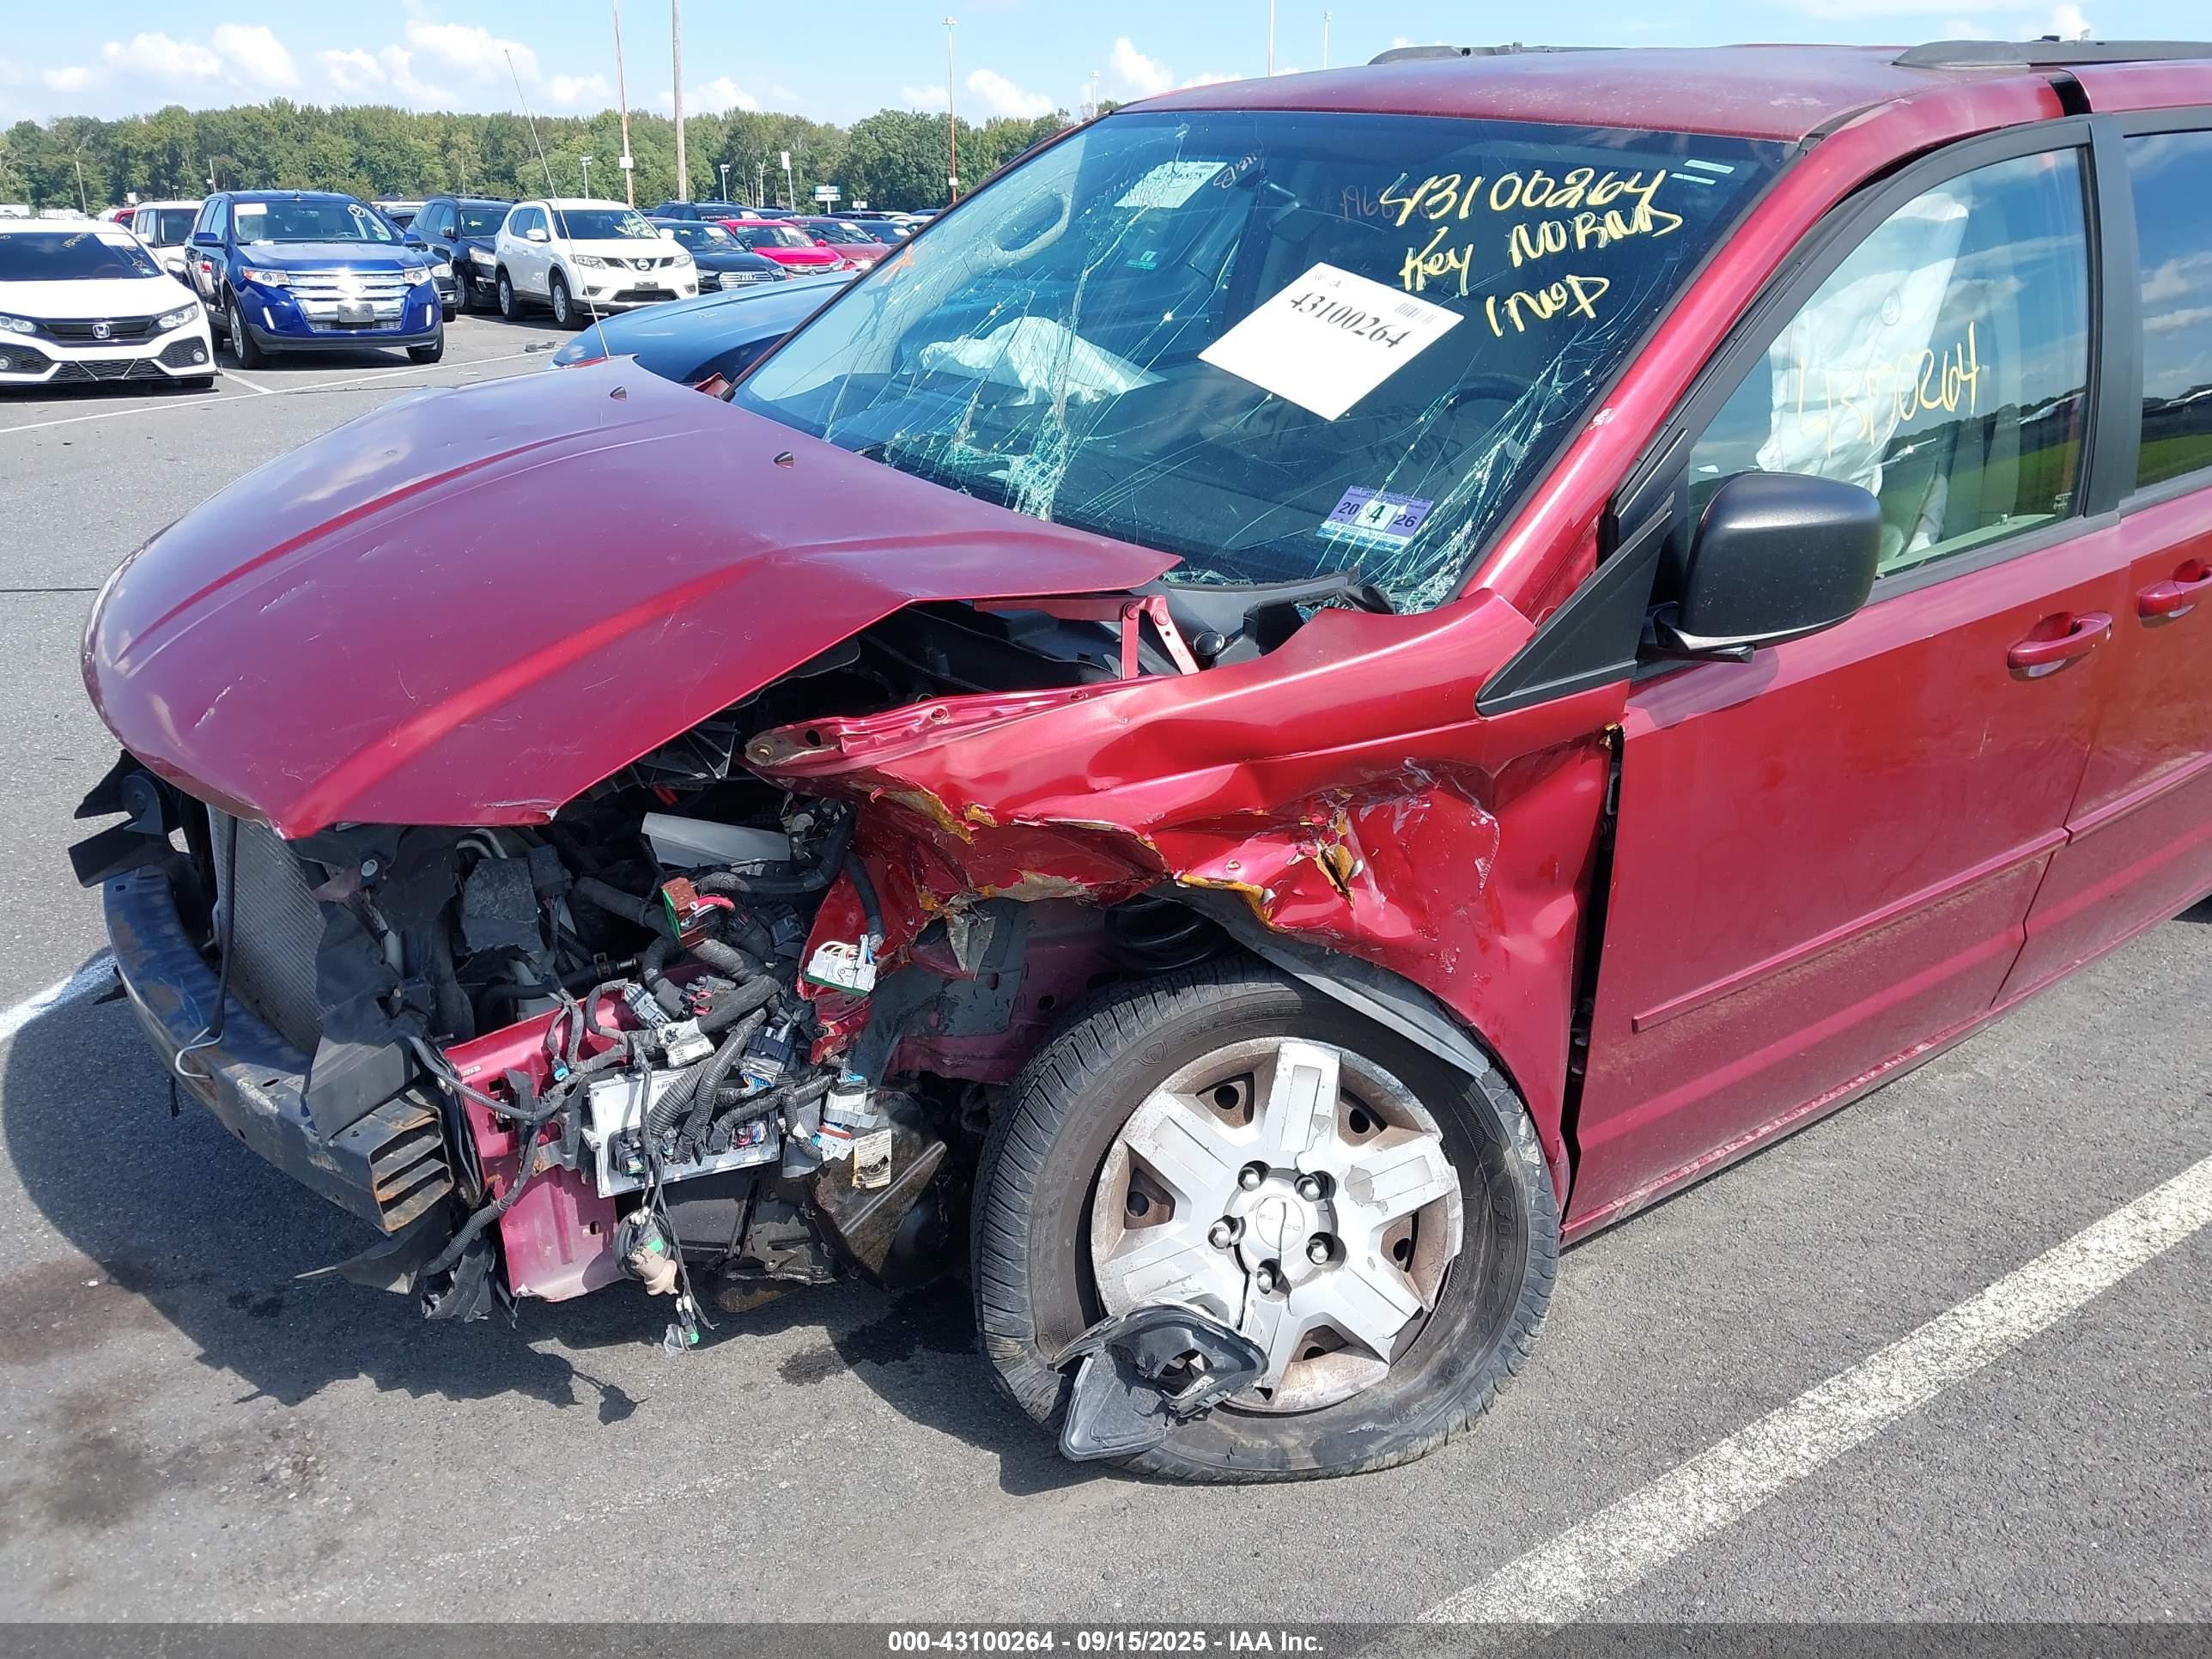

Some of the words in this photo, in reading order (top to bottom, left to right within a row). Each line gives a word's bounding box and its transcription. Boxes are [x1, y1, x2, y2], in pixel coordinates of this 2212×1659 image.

[1379, 168, 1667, 228] 43100264
[1290, 292, 1412, 348] 43100264
[1338, 501, 1360, 515] 20
[1369, 504, 1386, 524] 4
[1394, 514, 1418, 528] 26
